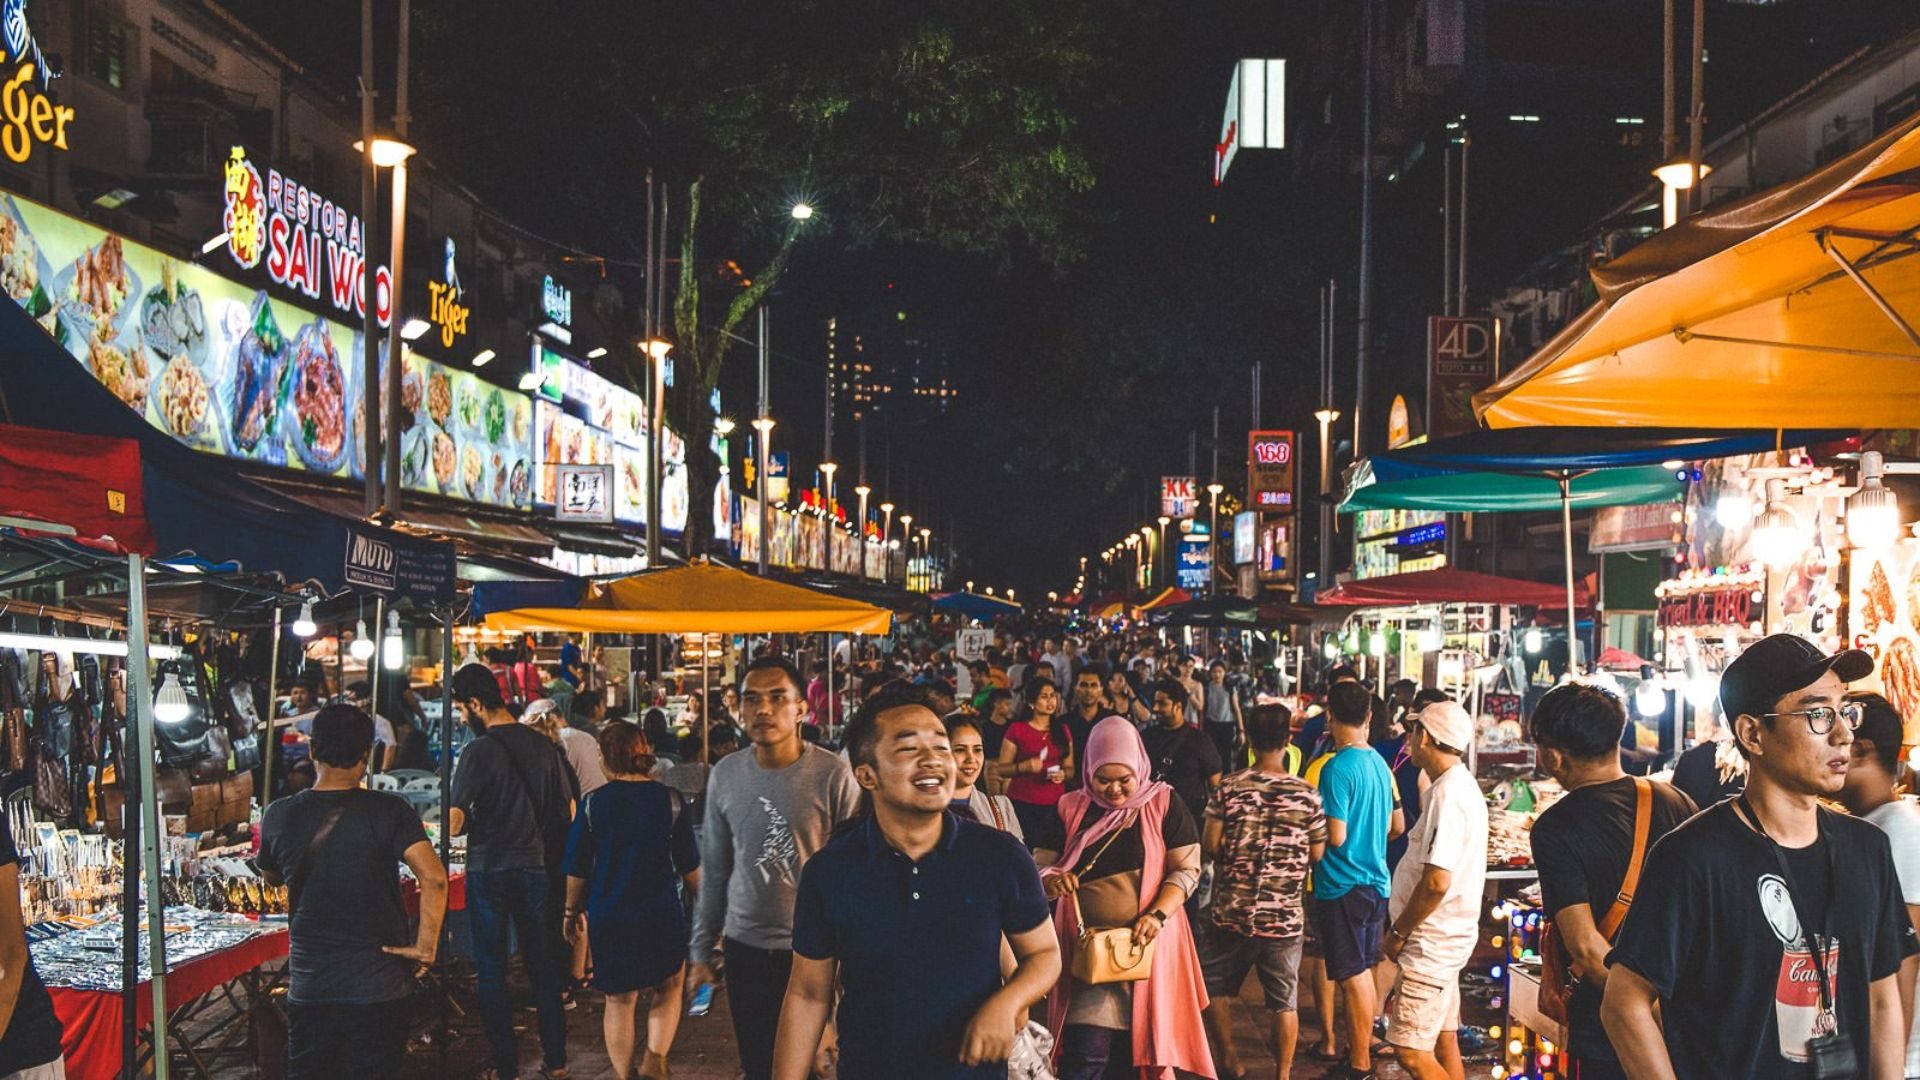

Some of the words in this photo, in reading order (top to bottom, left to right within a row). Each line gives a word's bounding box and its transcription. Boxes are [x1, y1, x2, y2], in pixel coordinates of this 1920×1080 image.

[0, 51, 75, 163] ger
[268, 169, 366, 253] RESTORA
[268, 212, 321, 299] SAI
[428, 280, 469, 348] Tiger
[1438, 323, 1489, 359] 4D
[1256, 442, 1290, 464] 168
[1166, 478, 1192, 498] KK
[351, 534, 393, 571] MUTO
[1695, 593, 1708, 625] &
[1712, 588, 1751, 630] BBQ
